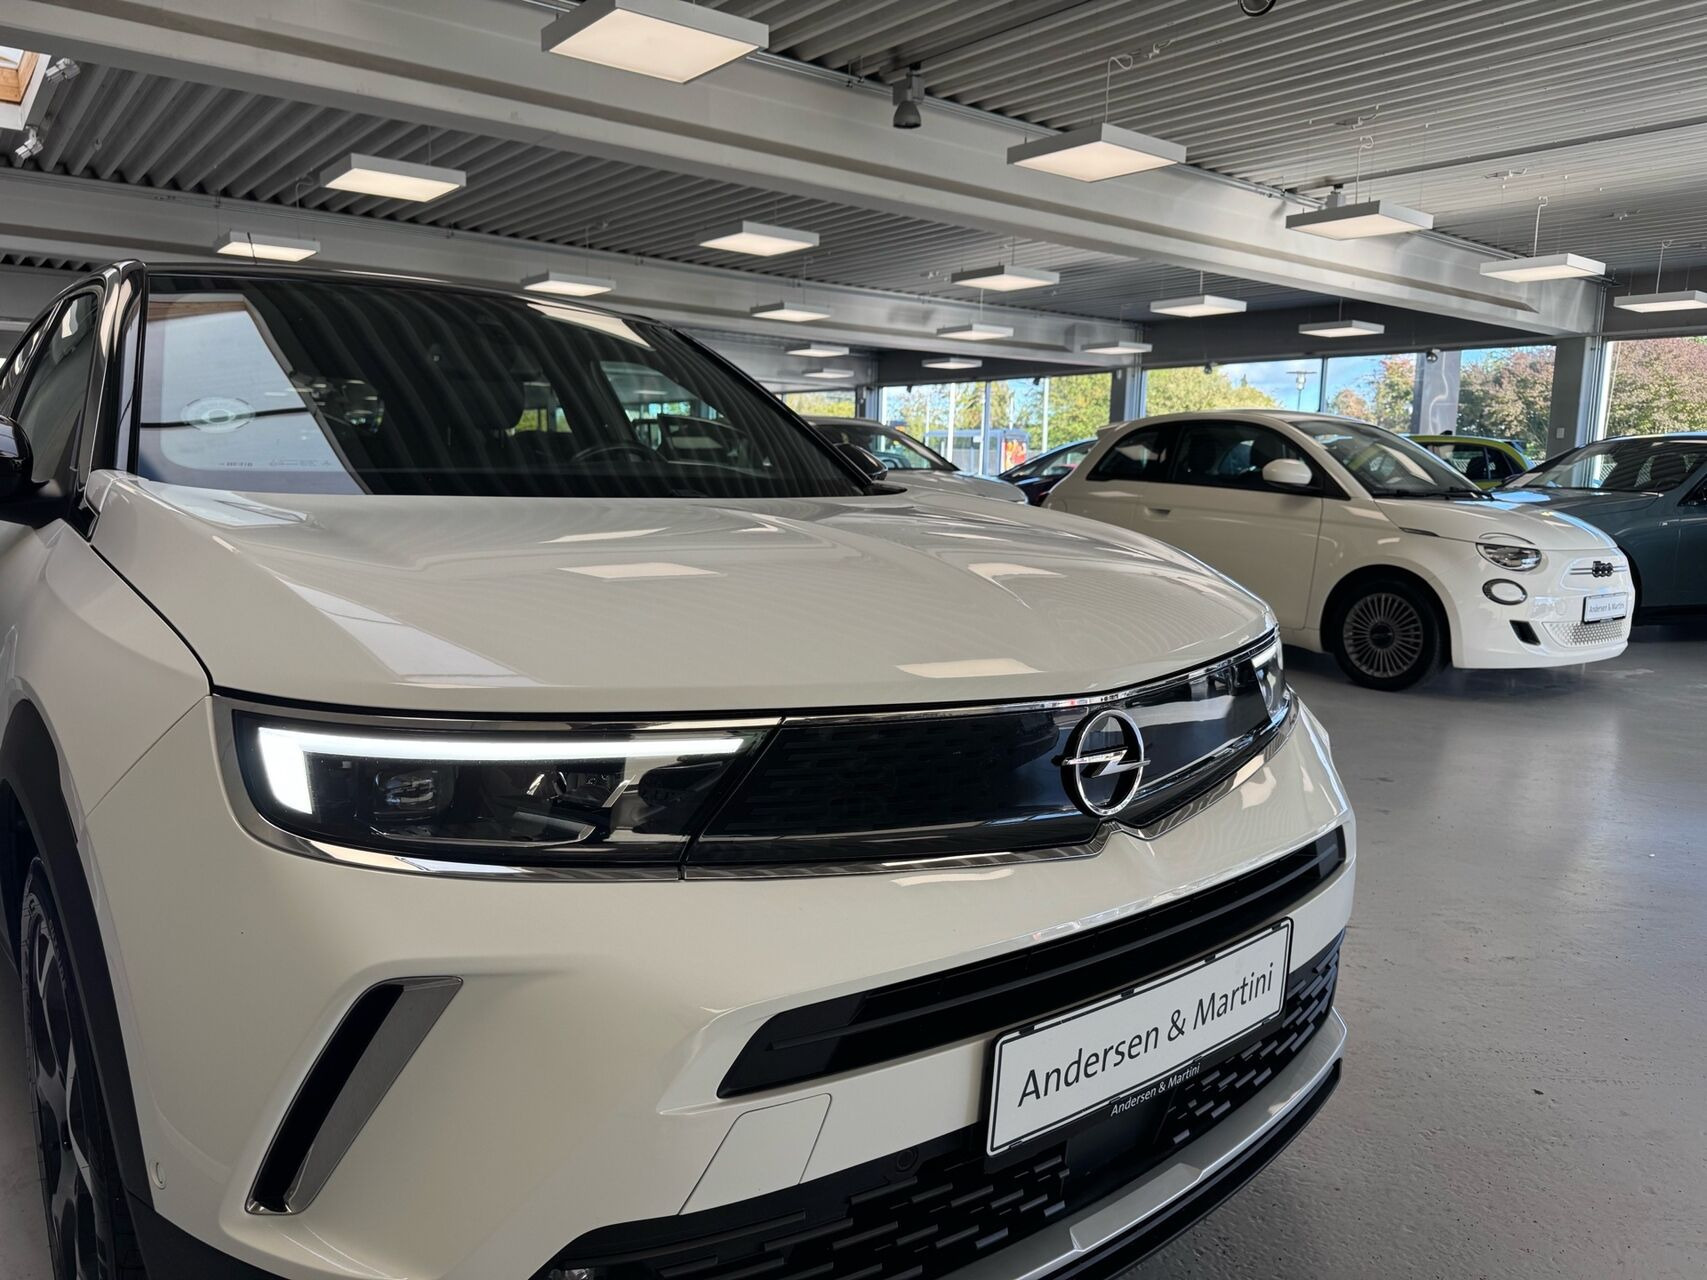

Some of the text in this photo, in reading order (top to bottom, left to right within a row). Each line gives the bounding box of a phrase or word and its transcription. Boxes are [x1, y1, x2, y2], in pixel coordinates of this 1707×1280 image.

[1018, 962, 1273, 1107] Andersen & Martini
[1111, 1063, 1200, 1117] Andersen & Martini
